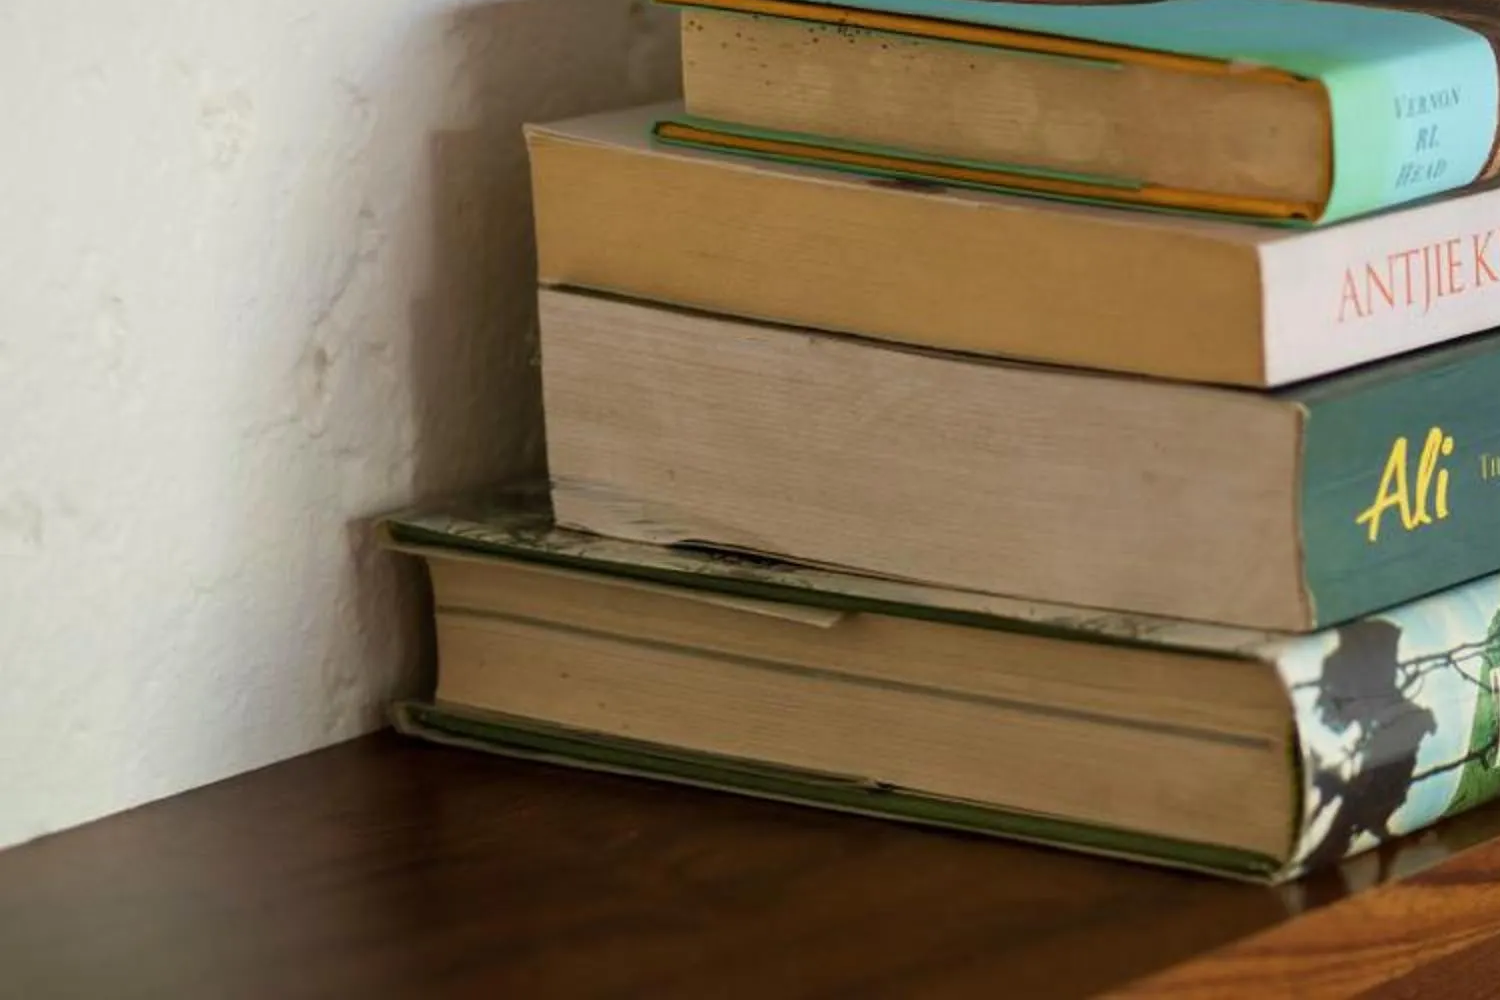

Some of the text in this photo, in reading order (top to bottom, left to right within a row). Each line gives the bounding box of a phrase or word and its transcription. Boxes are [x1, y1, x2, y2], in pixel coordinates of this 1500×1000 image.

[1393, 83, 1461, 120] VERNON
[1337, 238, 1465, 323] ANTJIE
[1355, 425, 1454, 543] Ali
